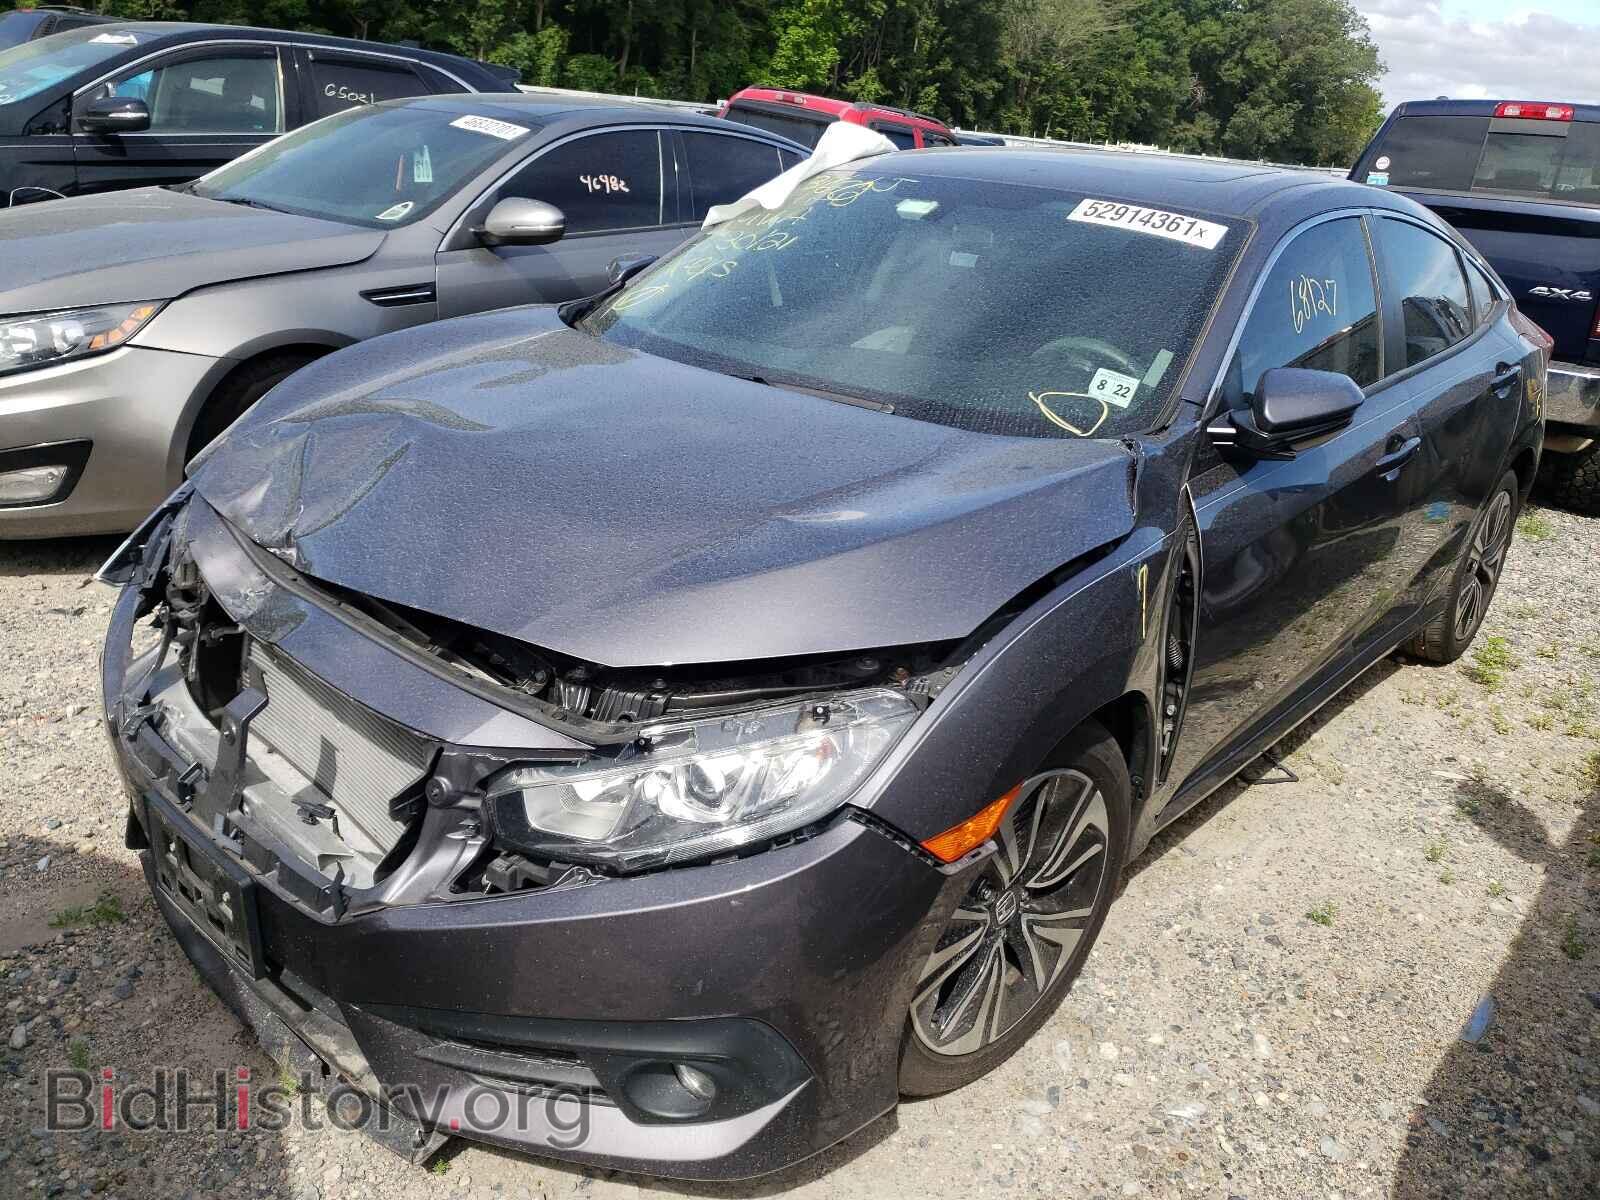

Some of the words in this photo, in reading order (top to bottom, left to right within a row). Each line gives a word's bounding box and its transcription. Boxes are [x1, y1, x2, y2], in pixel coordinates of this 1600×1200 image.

[1290, 274, 1337, 335] 68127
[1096, 379, 1108, 391] 8
[1112, 384, 1131, 399] 22
